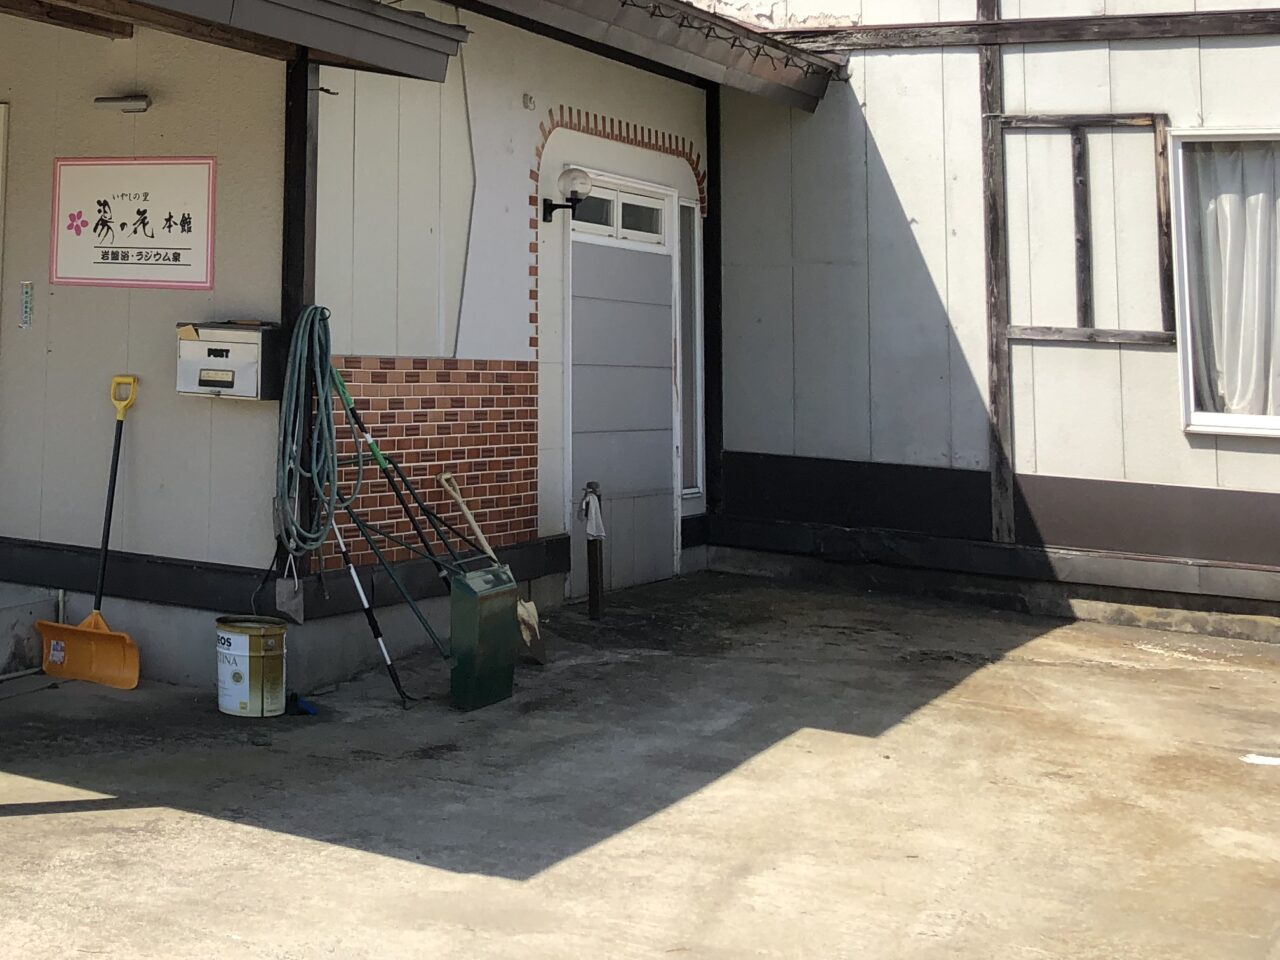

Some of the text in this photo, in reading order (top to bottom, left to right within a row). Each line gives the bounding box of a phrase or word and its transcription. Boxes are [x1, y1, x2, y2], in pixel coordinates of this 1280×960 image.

[112, 192, 150, 202] いやしの里
[162, 212, 193, 235] 本館
[207, 348, 230, 358] POST
